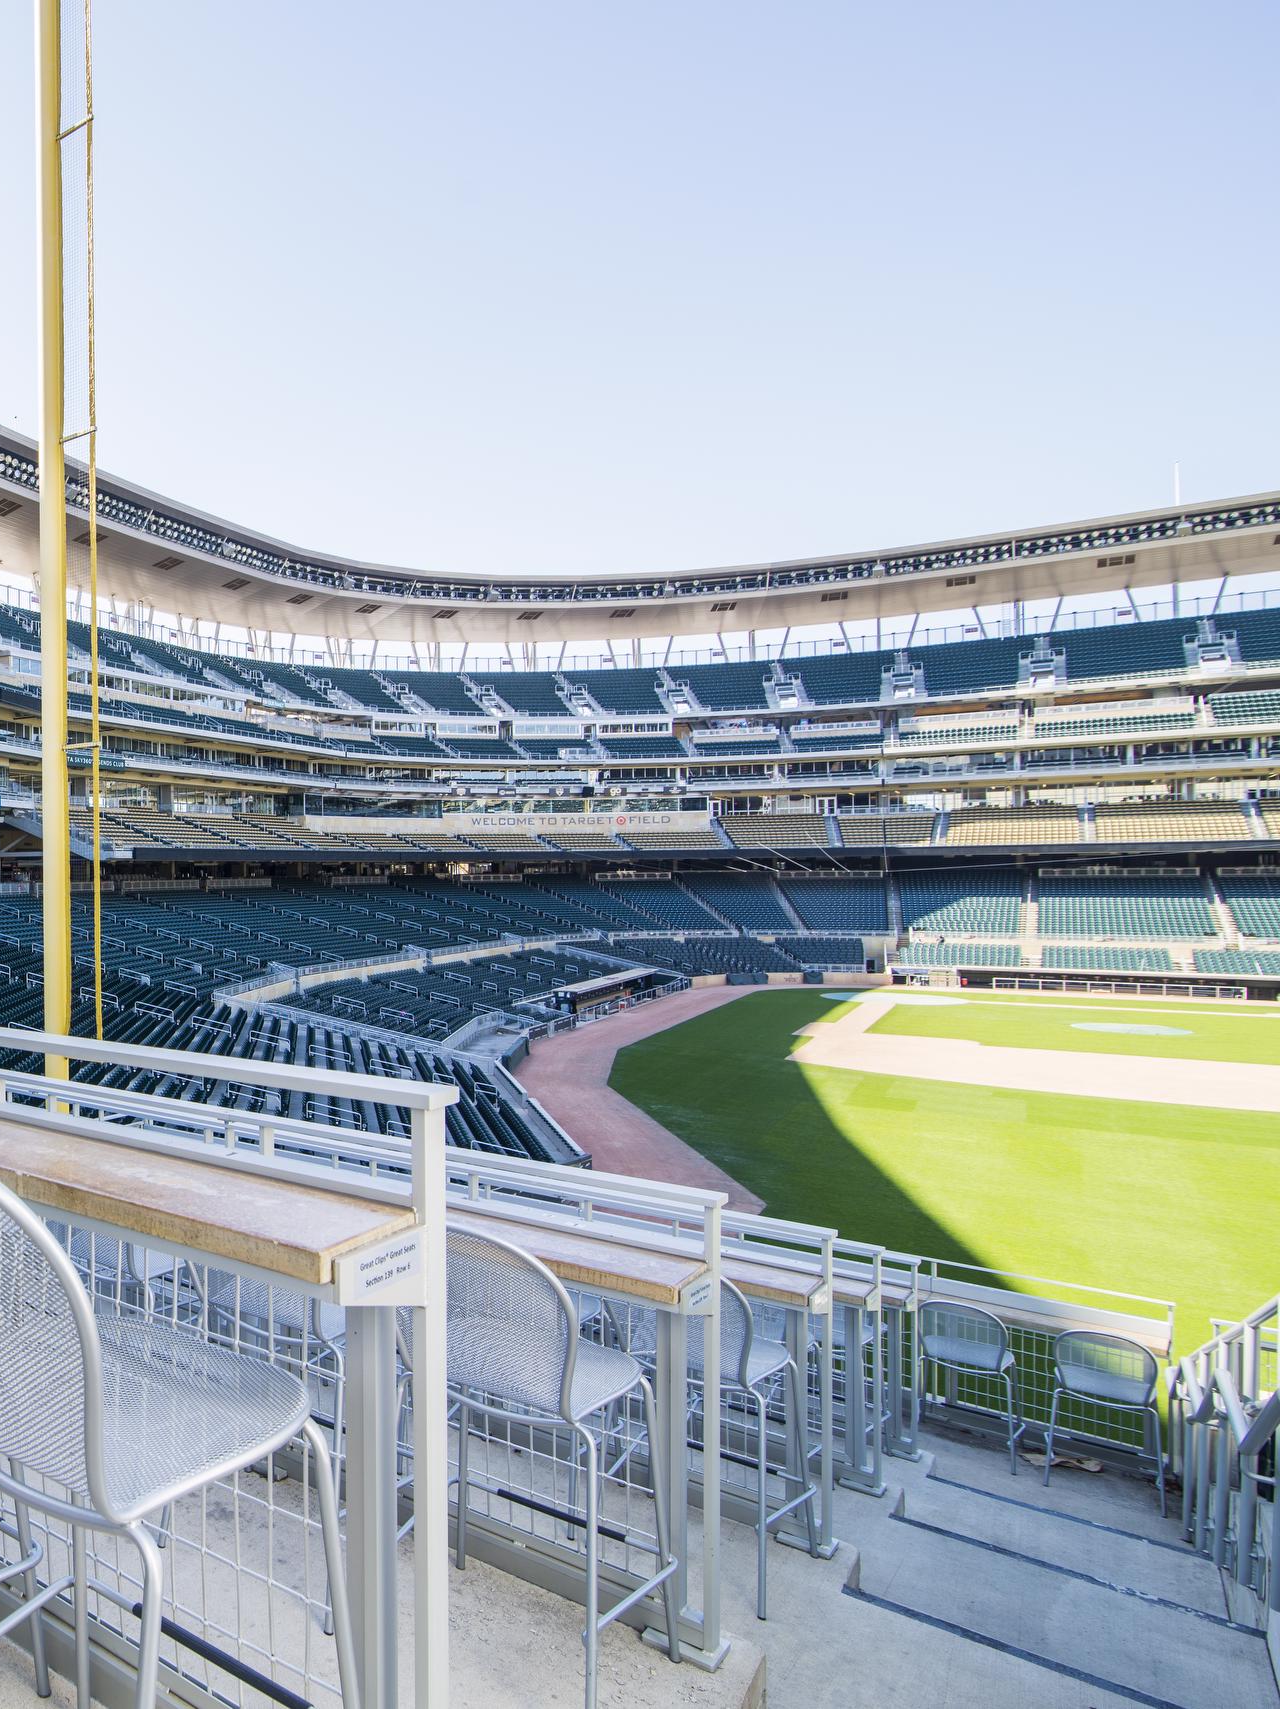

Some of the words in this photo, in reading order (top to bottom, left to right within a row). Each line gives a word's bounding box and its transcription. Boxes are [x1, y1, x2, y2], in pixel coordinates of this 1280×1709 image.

[472, 817, 535, 826] WELCOME
[539, 817, 557, 826] TO
[561, 816, 613, 825] TARGET
[629, 815, 671, 824] FIELD
[360, 1261, 375, 1272] Great
[389, 1248, 403, 1260] Great
[403, 1243, 417, 1253] Seats
[365, 1274, 384, 1288] Section
[396, 1266, 407, 1274] Row
